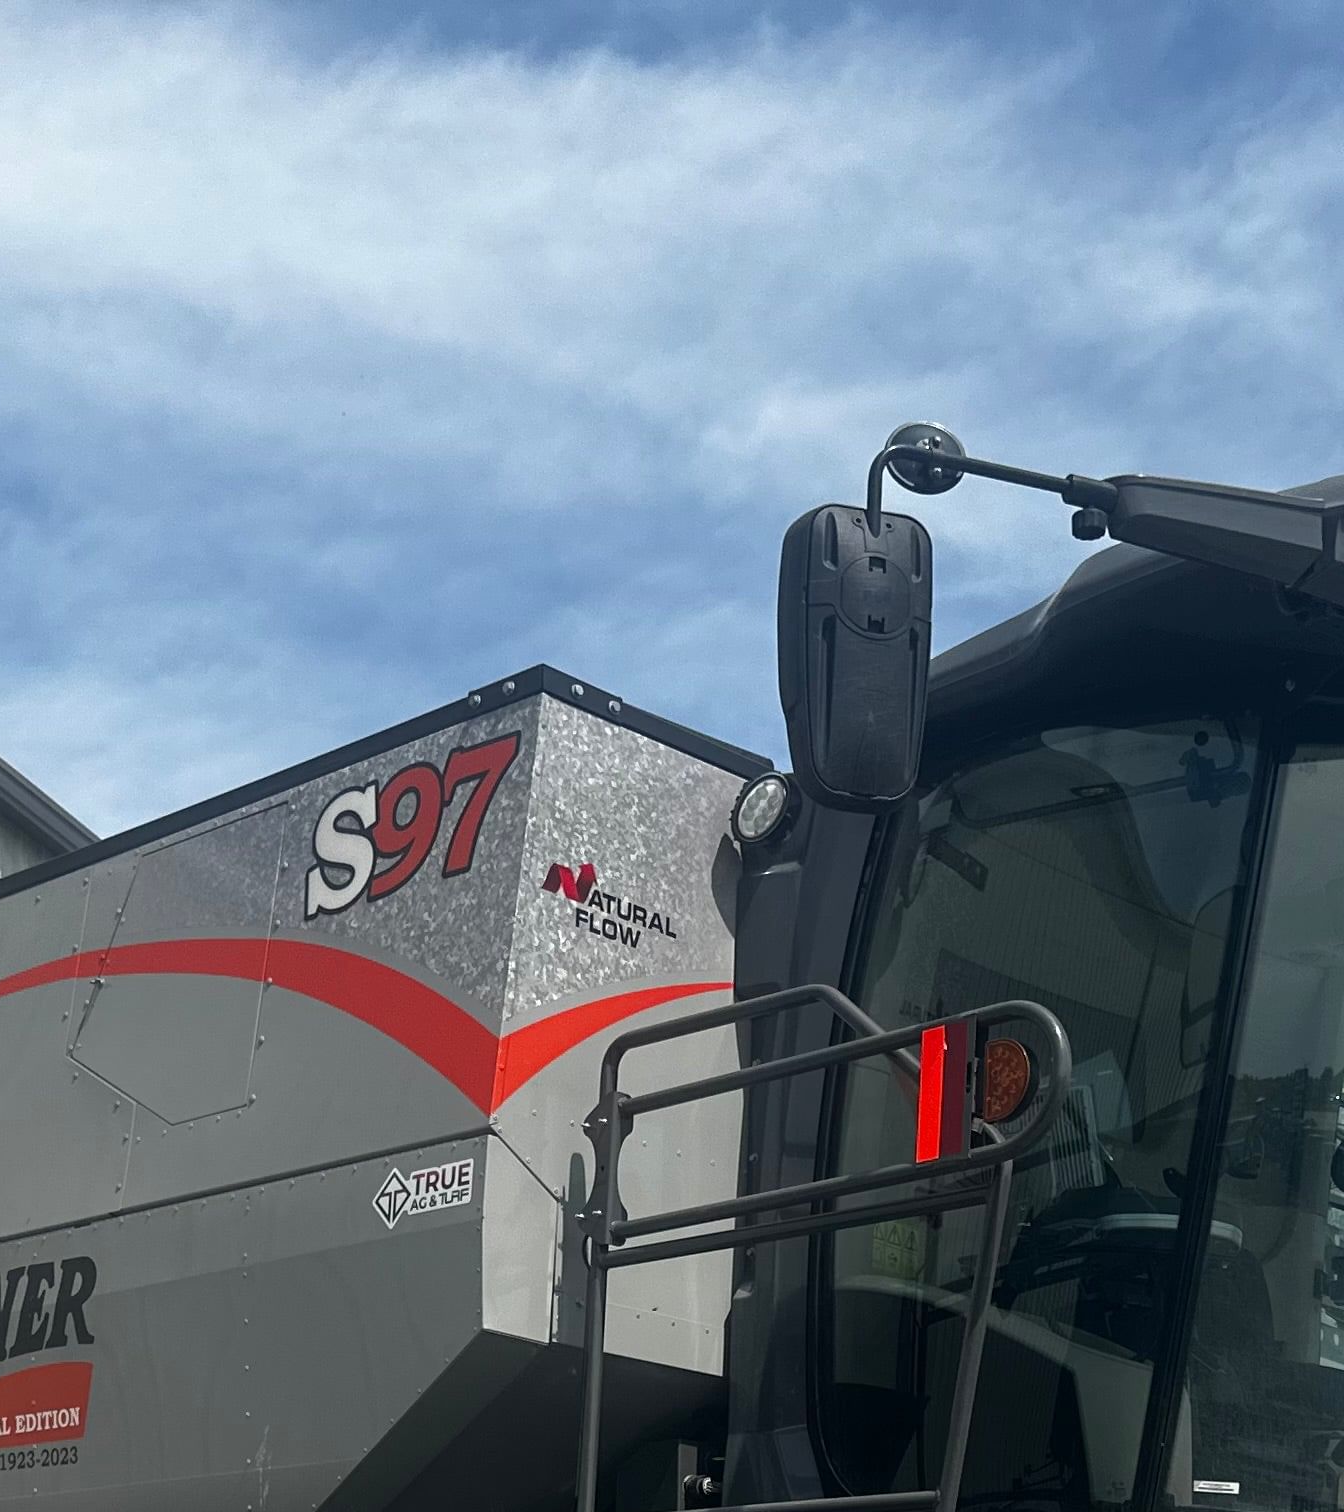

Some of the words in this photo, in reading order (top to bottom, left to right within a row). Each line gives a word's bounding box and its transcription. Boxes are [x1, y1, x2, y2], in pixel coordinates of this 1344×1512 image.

[304, 730, 522, 920] S97
[541, 862, 677, 939] NATURAL
[575, 909, 642, 949] FLOW
[412, 1162, 471, 1196] TRUE
[409, 1198, 427, 1211] AG
[429, 1196, 437, 1207] &
[439, 1188, 470, 1205] TURF
[15, 1407, 80, 1435] EDITION
[0, 1447, 79, 1471] 1923-2023
